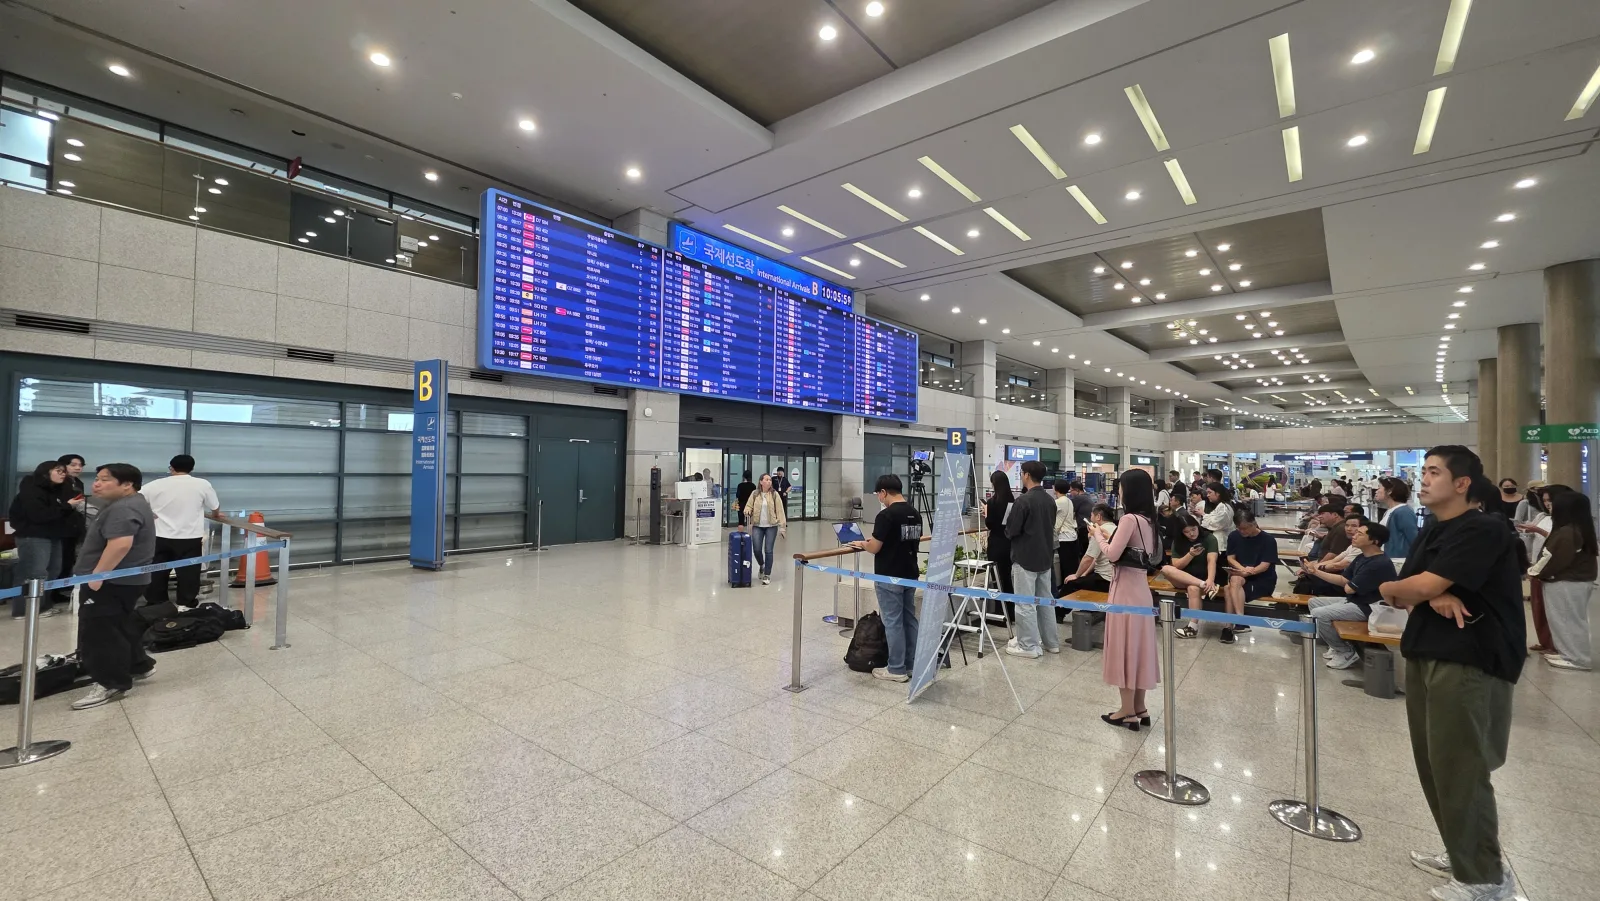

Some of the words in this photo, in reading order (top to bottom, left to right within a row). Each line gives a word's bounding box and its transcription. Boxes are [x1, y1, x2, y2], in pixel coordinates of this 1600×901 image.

[704, 243, 754, 274] 국제선도착
[757, 269, 792, 288] International
[792, 282, 810, 294] Arrivals
[812, 282, 818, 296] B
[419, 370, 432, 402] B
[952, 432, 962, 446] B
[140, 564, 166, 572] SECURITY
[927, 583, 956, 592] SECURITY
